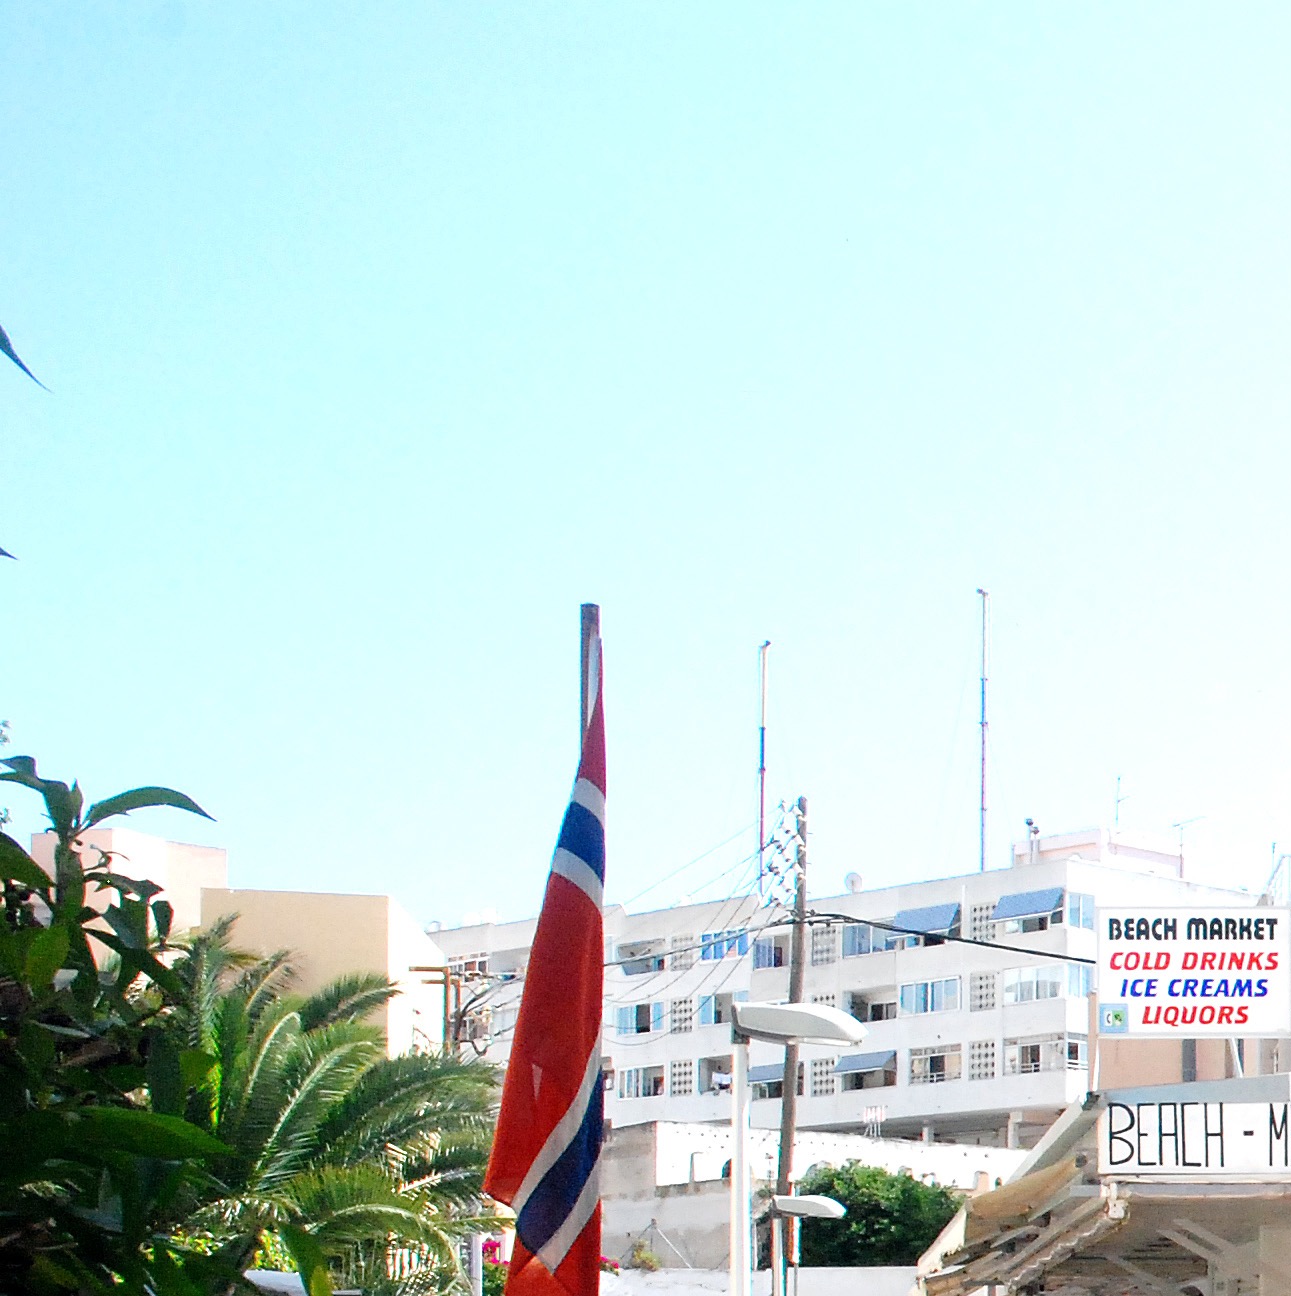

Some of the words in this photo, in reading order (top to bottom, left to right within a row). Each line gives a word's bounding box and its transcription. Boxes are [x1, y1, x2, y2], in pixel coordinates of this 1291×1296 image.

[1109, 918, 1177, 941] BEACH
[1187, 918, 1279, 941] MARKET
[1109, 952, 1171, 971] COLD
[1181, 952, 1279, 971] DRINKS
[1120, 979, 1158, 998] ICE
[1167, 979, 1269, 998] CREAMS
[1141, 1005, 1250, 1027] LIQUORS
[1107, 1102, 1225, 1168] BEACH
